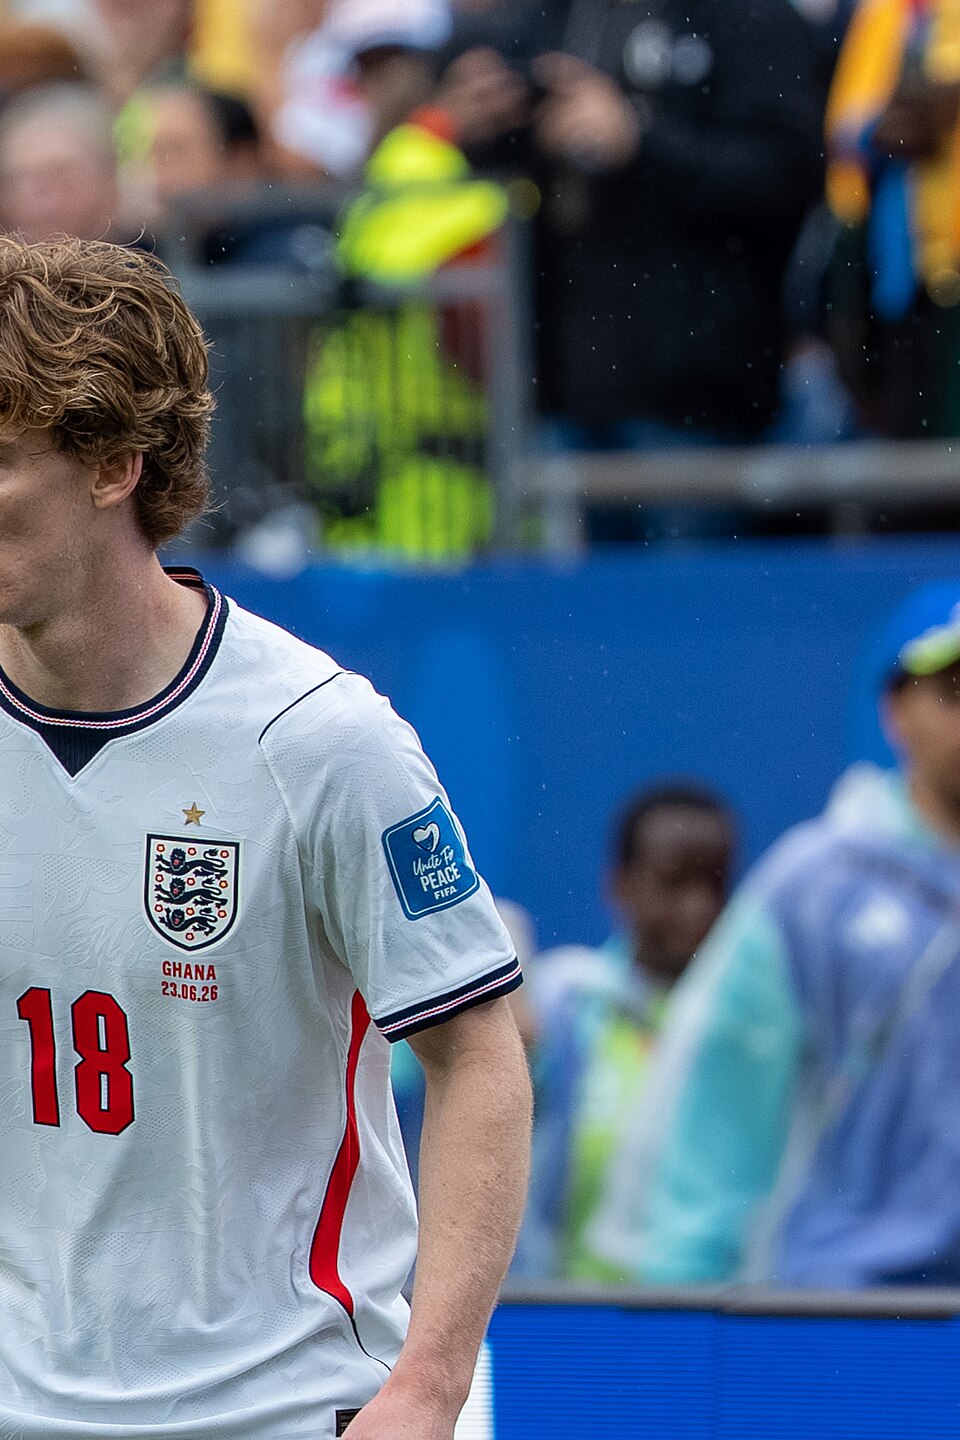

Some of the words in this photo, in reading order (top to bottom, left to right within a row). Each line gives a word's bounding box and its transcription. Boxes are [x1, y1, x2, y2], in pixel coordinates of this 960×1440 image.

[413, 854, 442, 876] Unite
[420, 861, 462, 892] PEACE
[433, 885, 458, 900] FIFA
[162, 960, 217, 981] GHANA
[161, 980, 219, 1002] 23.06.26
[16, 986, 135, 1136] 18
